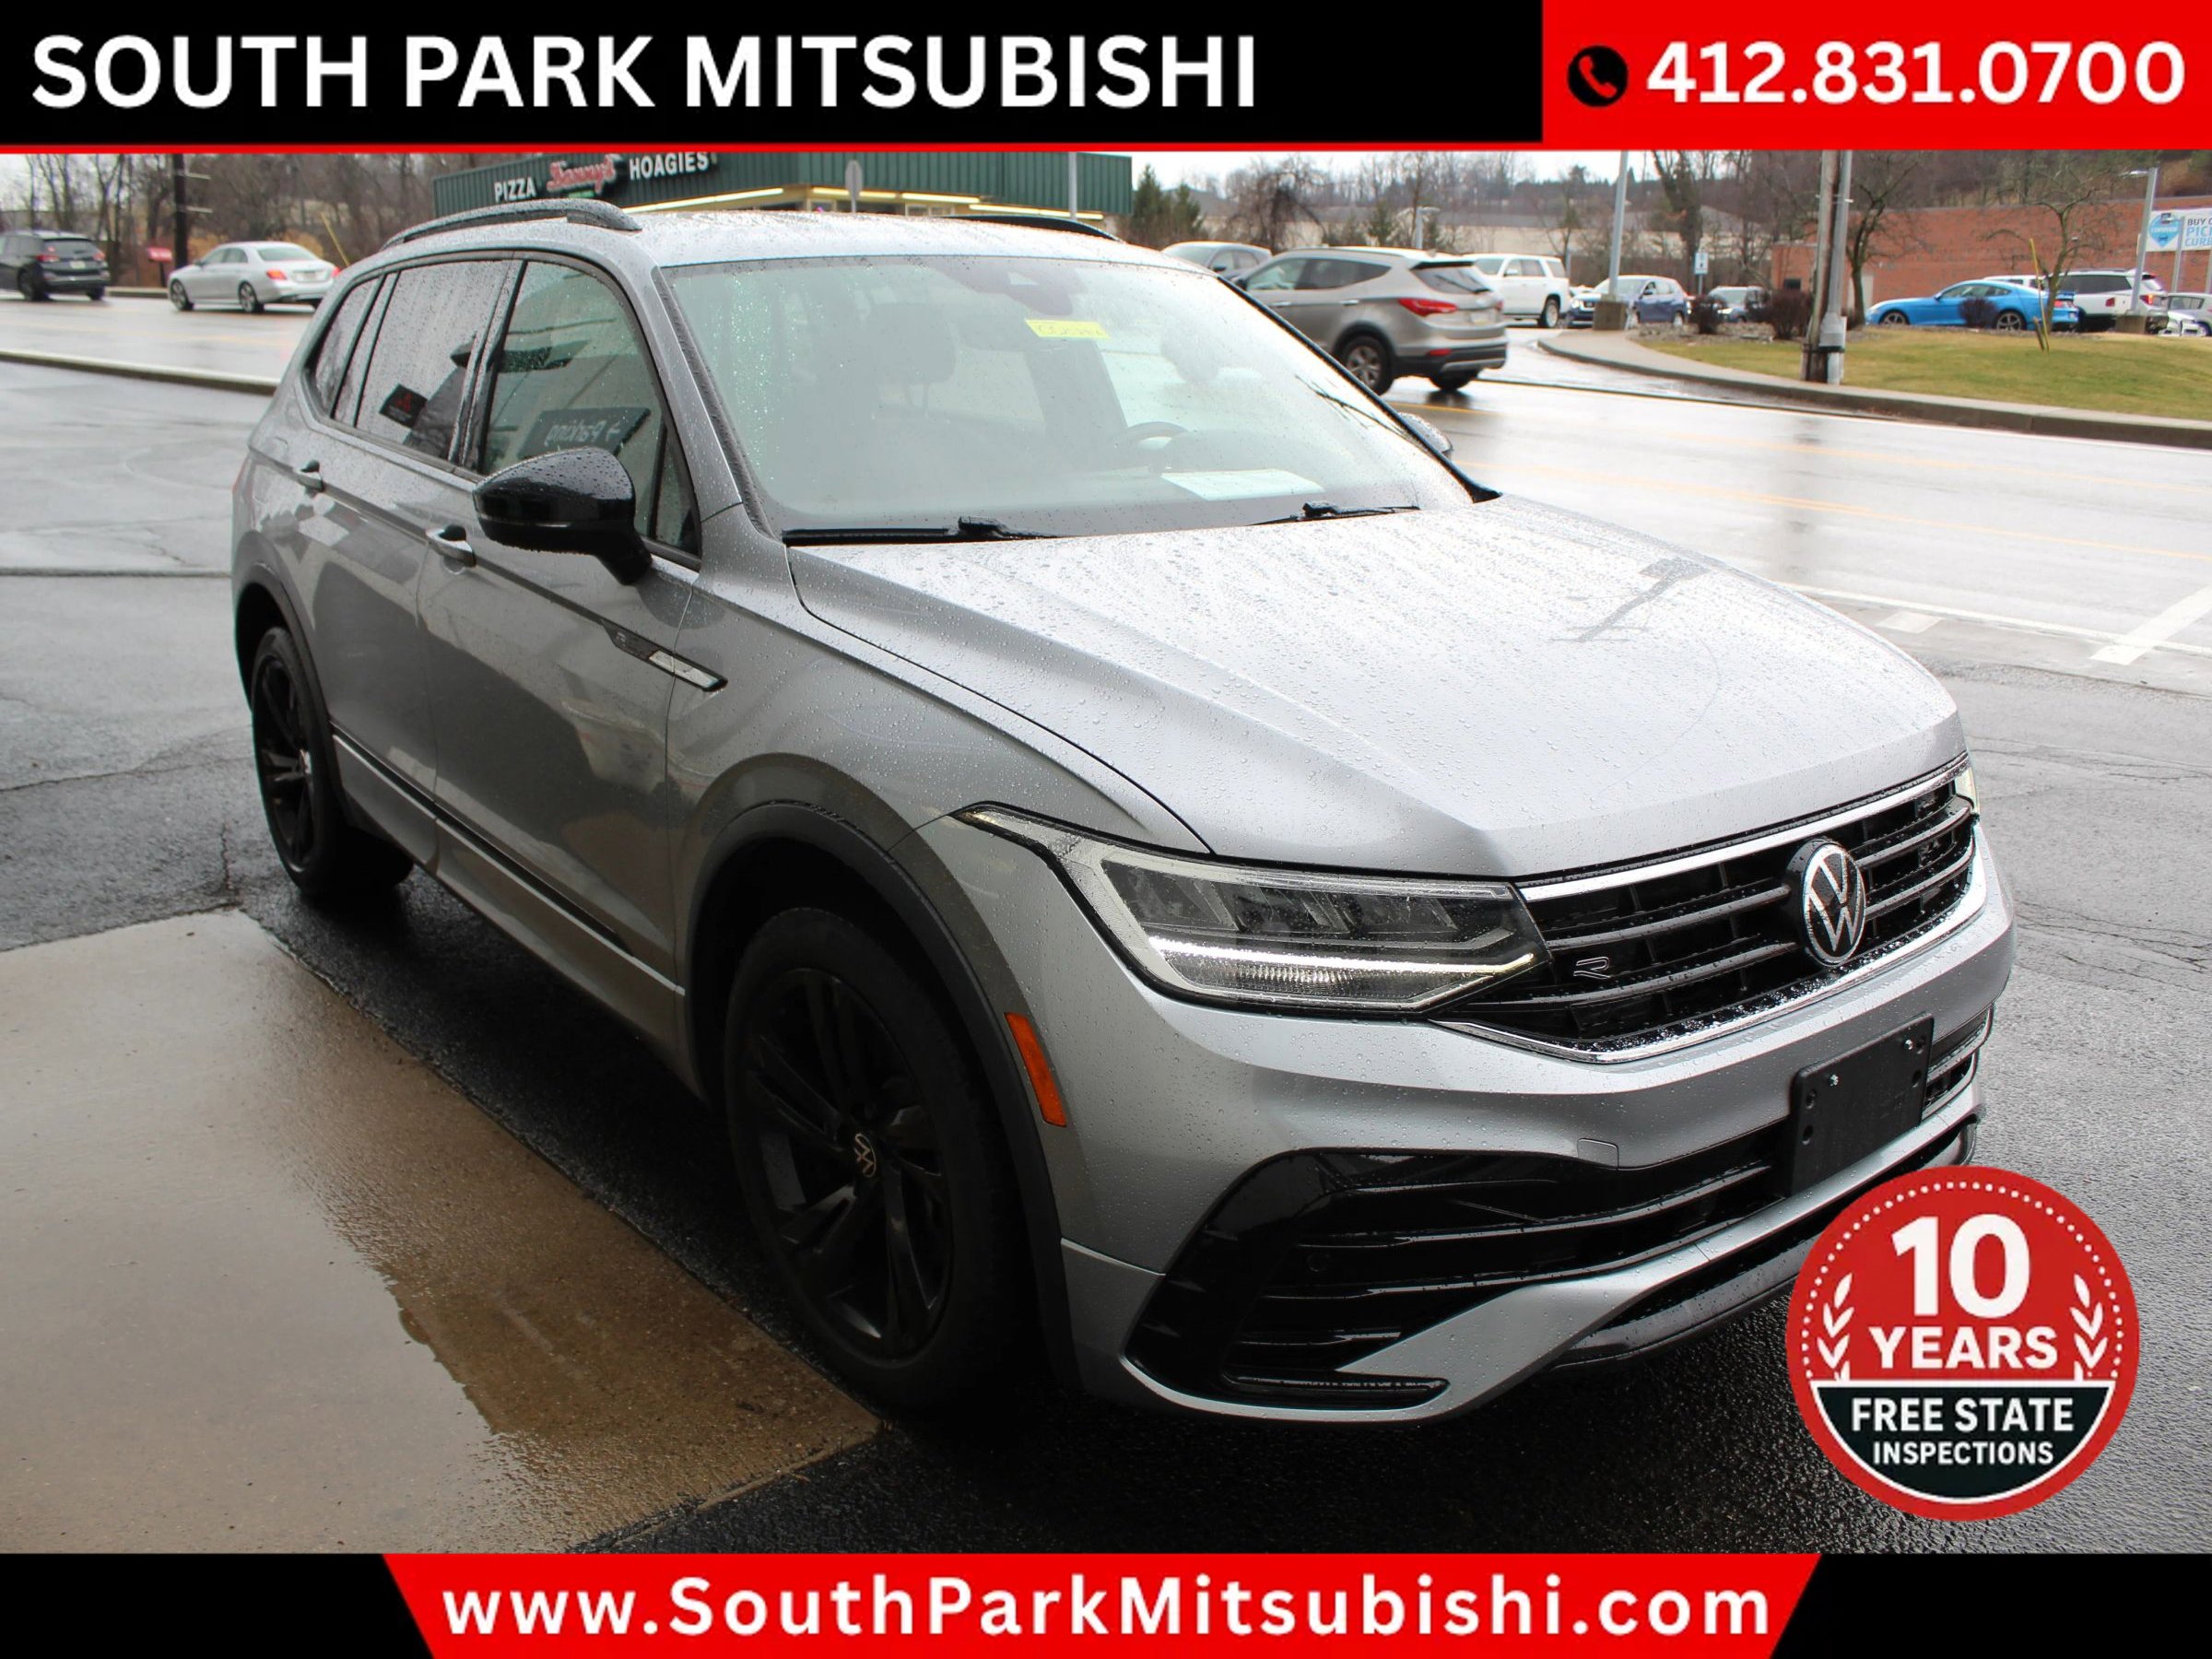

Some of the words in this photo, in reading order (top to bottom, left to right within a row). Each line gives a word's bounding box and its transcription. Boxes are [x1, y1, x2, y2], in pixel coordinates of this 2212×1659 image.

[494, 176, 536, 203] PIZZA
[629, 152, 709, 181] HOAGIES
[2188, 218, 2206, 227] BUY
